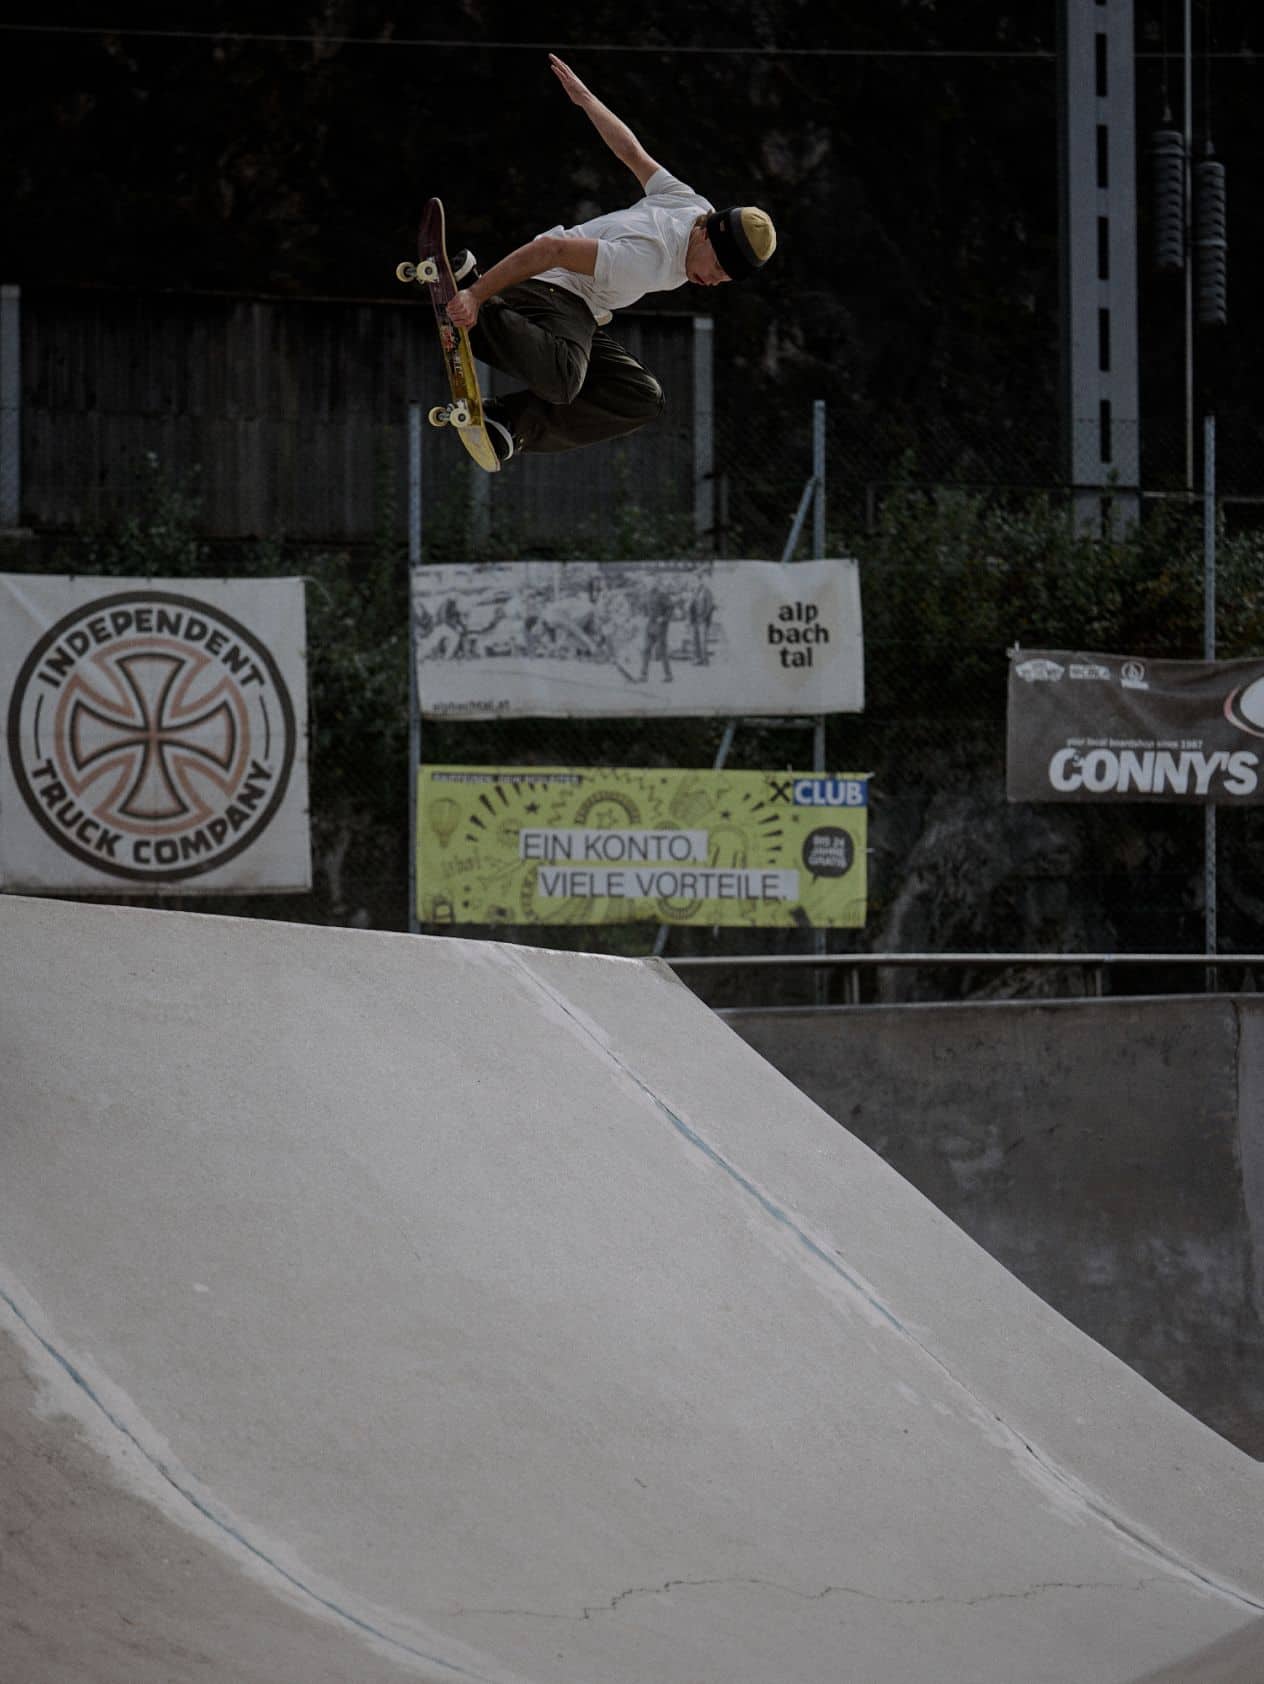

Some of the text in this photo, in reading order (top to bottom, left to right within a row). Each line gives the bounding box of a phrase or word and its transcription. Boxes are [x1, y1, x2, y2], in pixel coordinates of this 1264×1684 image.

[778, 601, 819, 625] alp
[38, 608, 265, 688] INDEPENDENT
[768, 623, 830, 645] bach
[780, 647, 813, 668] tal
[1048, 747, 1260, 796] CONNY'S
[795, 780, 864, 805] CLUB
[32, 759, 272, 865] TRUCK COMPANY
[523, 833, 572, 862] EIN
[541, 871, 787, 901] VIELE VORTEILE.
